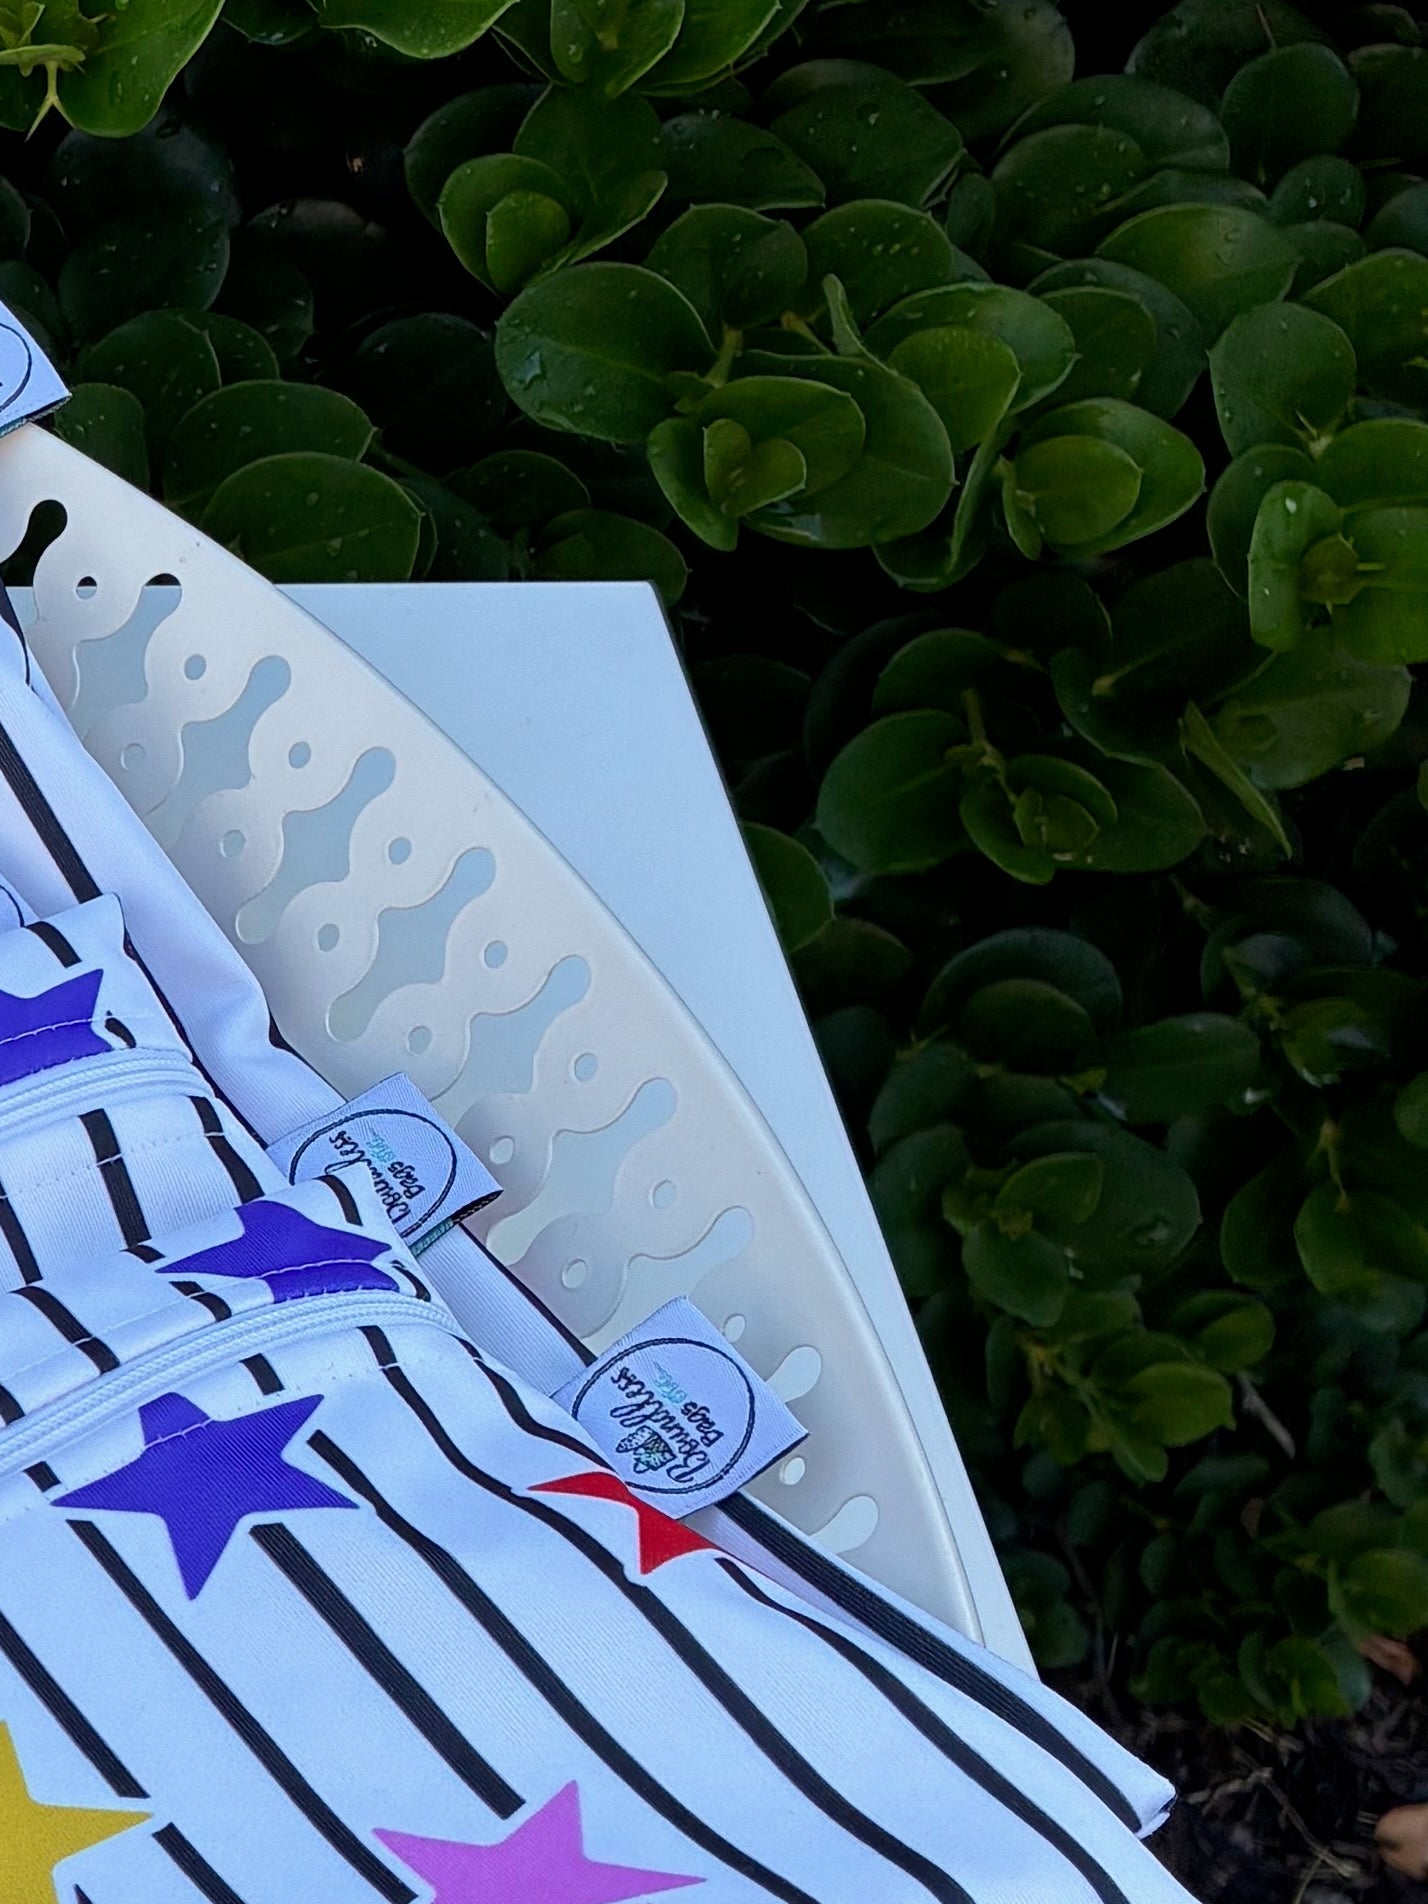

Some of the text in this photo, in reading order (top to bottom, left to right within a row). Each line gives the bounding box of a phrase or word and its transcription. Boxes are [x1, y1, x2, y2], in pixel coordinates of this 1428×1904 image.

[388, 1160, 426, 1200] Bags
[609, 1366, 711, 1484] Boundless
[681, 1401, 724, 1448] Bags
